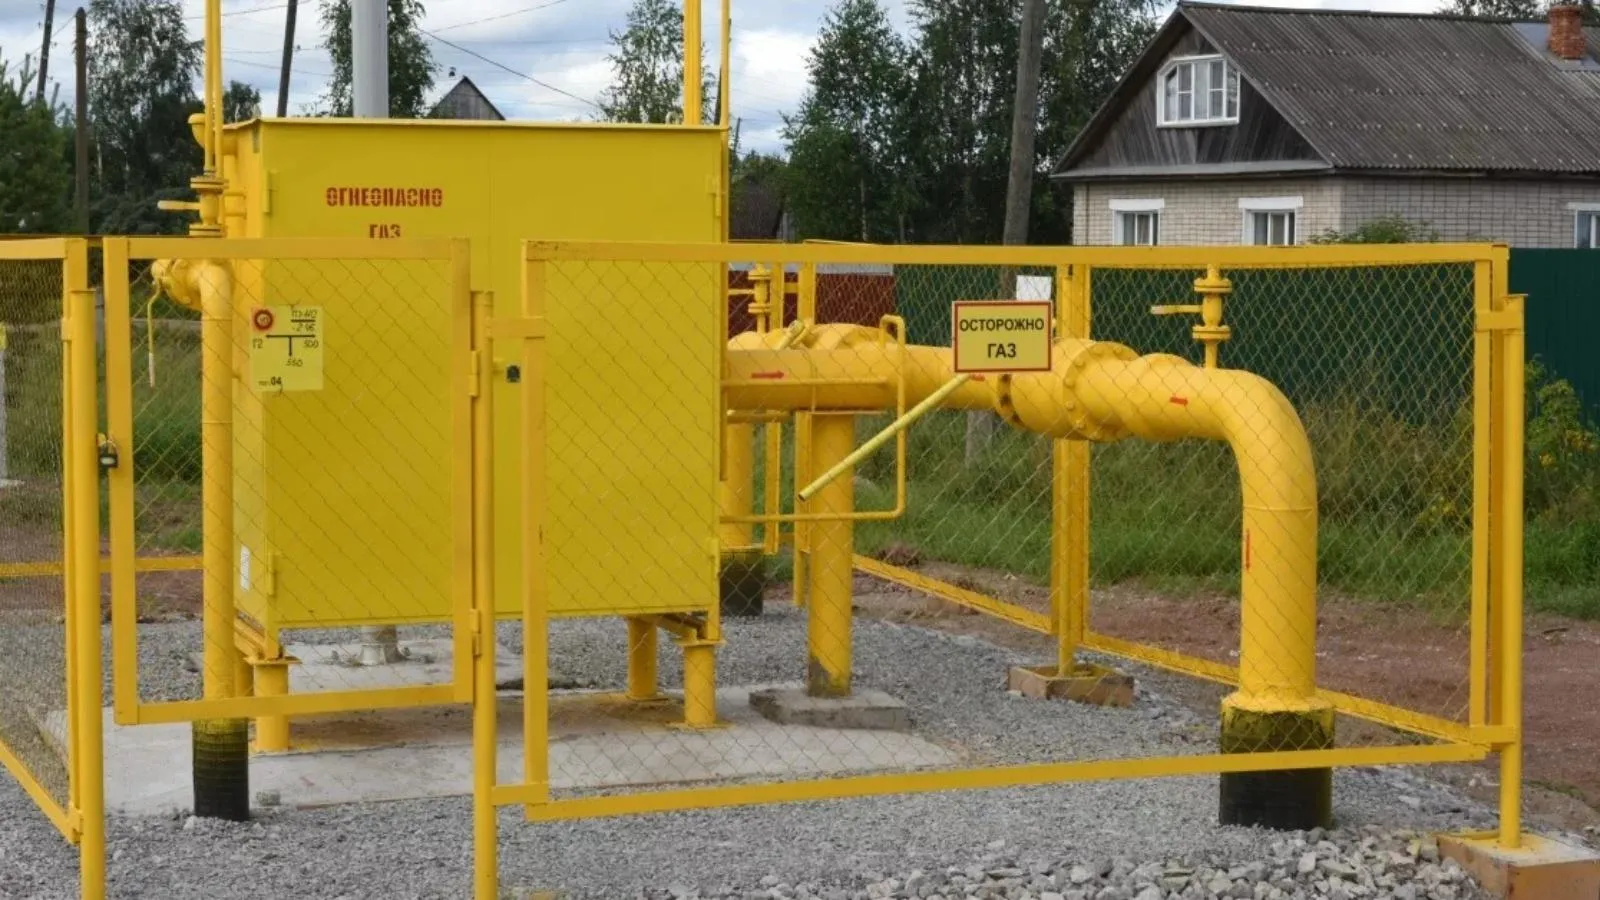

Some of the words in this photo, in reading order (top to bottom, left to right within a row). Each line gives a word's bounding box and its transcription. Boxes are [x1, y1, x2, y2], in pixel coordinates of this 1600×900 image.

[326, 187, 442, 207] ОГНЕОПАСНО
[369, 224, 400, 238] ГАЗ
[960, 318, 1044, 331] ОСТОРОЖНО
[987, 343, 1017, 358] ГАЗ
